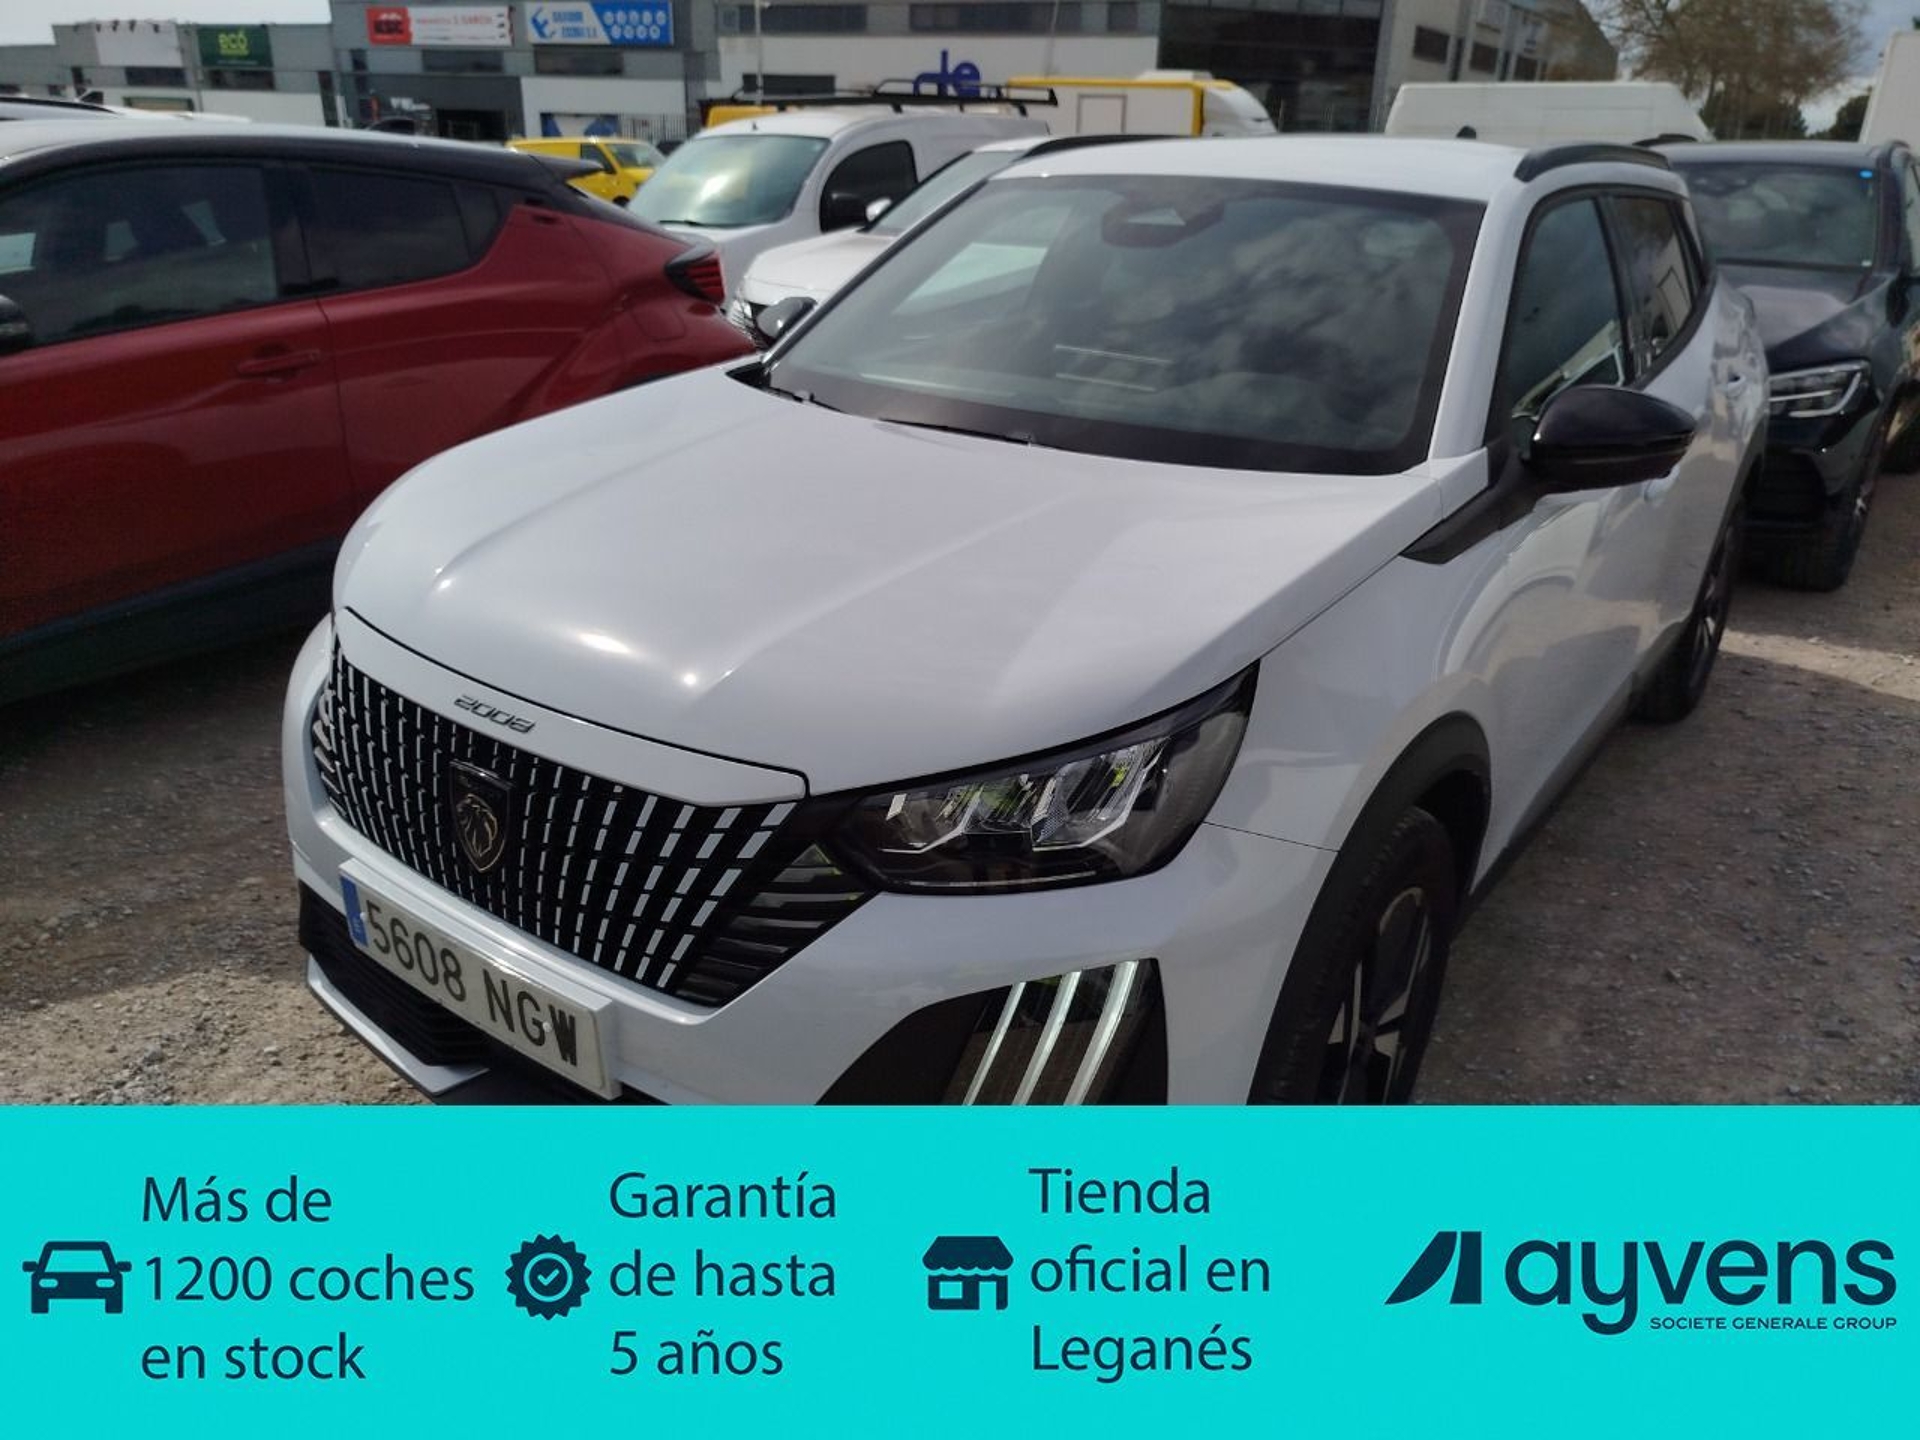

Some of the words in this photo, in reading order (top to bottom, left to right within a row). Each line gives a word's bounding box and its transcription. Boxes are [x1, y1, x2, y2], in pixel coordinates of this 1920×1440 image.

[454, 695, 536, 733] 2008
[367, 900, 466, 1002] 5608
[483, 969, 577, 1067] NGW
